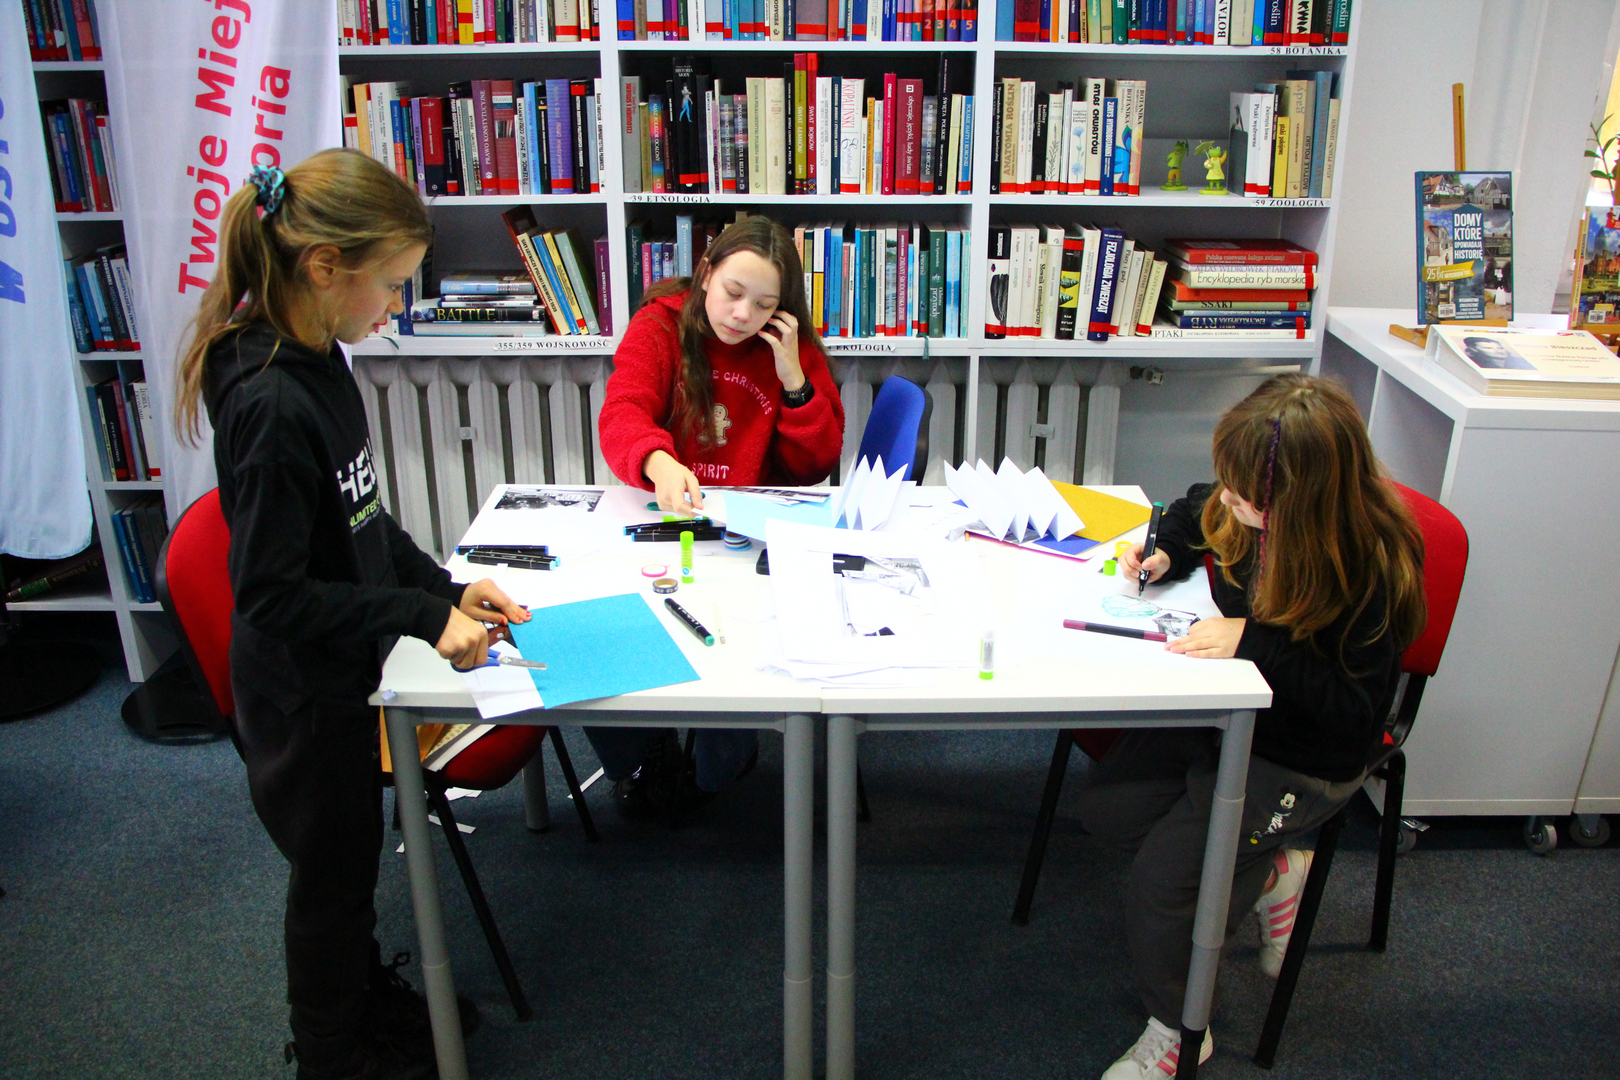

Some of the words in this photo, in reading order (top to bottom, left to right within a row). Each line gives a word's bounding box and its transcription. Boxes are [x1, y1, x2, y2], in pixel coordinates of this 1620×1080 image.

[915, 21, 921, 32] 1
[924, 18, 932, 30] 2
[936, 19, 945, 30] 3
[948, 19, 958, 30] 4
[964, 19, 973, 30] 5
[1270, 46, 1281, 55] 58
[1285, 46, 1342, 56] BOTANIKA
[1004, 83, 1016, 121] ROŚLIN
[1093, 83, 1101, 106] ATLAS
[1293, 85, 1307, 114] gady
[842, 84, 858, 128] KOPALIŃSKI
[1106, 101, 1115, 118] ZARYS
[1124, 88, 1132, 124] BOTANIKA
[1137, 89, 1145, 125] BOTANIKA
[479, 91, 490, 143] KONSTYTUCYJNE
[517, 104, 525, 136] CODZIENNYM
[1264, 105, 1272, 127] Zwierzęta
[906, 122, 914, 141] języki,
[1090, 108, 1100, 155] CHWASTÓW
[1104, 118, 1114, 157] HYDROBOTANIKI
[1278, 124, 1286, 136] ptaki
[1328, 118, 1336, 141] LEŚNYCH
[483, 144, 491, 166] PRAWO
[906, 142, 914, 154] ludy
[1003, 123, 1013, 176] ANATOMIA
[1277, 136, 1286, 156] pokojowe
[906, 155, 914, 174] świata
[1302, 162, 1310, 190] MOTYLE
[632, 194, 644, 203] 39
[646, 194, 711, 204] ETNOLOGIA
[1255, 199, 1266, 207] 59
[1269, 199, 1325, 208] ZOOLOGIA
[178, 134, 230, 294] Twoje
[1454, 213, 1482, 227] DOMY
[1454, 226, 1482, 241] KTÓRE
[1454, 241, 1483, 250] OPOWIADAJĄ
[1454, 249, 1484, 261] HISTORIĘ
[898, 256, 906, 275] ZMIANY
[1102, 241, 1118, 279] FIZJOLOGIA
[1123, 249, 1132, 265] Płazy
[1142, 258, 1151, 274] MUSZLI
[1247, 254, 1264, 262] księga
[1264, 254, 1285, 262] zwierząt
[520, 238, 528, 248] SIŁY
[524, 248, 536, 268] LOTNICZE
[533, 268, 542, 282] POLSKI
[541, 284, 551, 302] NIEMIEC
[550, 302, 558, 313] 1939
[1038, 263, 1046, 284] Słownik
[1119, 270, 1128, 284] gady
[1197, 272, 1255, 285] Encyklopedia
[1256, 272, 1273, 285] ryb
[1274, 273, 1306, 284] morskic
[1219, 265, 1264, 273] WĘDRÓWEK
[1426, 267, 1436, 281] 25
[101, 255, 114, 286] STOSUNKI
[109, 286, 126, 334] MIĘDZYNARODOWE
[116, 266, 132, 314] MIĘDZYNARODOWE
[898, 275, 907, 307] ŚRODOWISKA
[1095, 280, 1113, 314] ZWIERZĄT
[929, 287, 938, 319] przyrody
[1034, 285, 1044, 326] entomologiczny
[1200, 300, 1233, 309] SSAKI
[436, 308, 496, 321] BATTLE
[898, 306, 906, 321] ZIEMI
[1190, 317, 1218, 329] RYB
[1154, 329, 1184, 338] PTAKI
[498, 342, 533, 350] 355/359
[536, 339, 610, 349] WOJSKOWOŚĆ
[139, 388, 148, 409] TEORIA
[723, 372, 773, 415] CHRISTMAS
[690, 462, 730, 480] SPIRIT
[52, 565, 88, 583] Britannica
